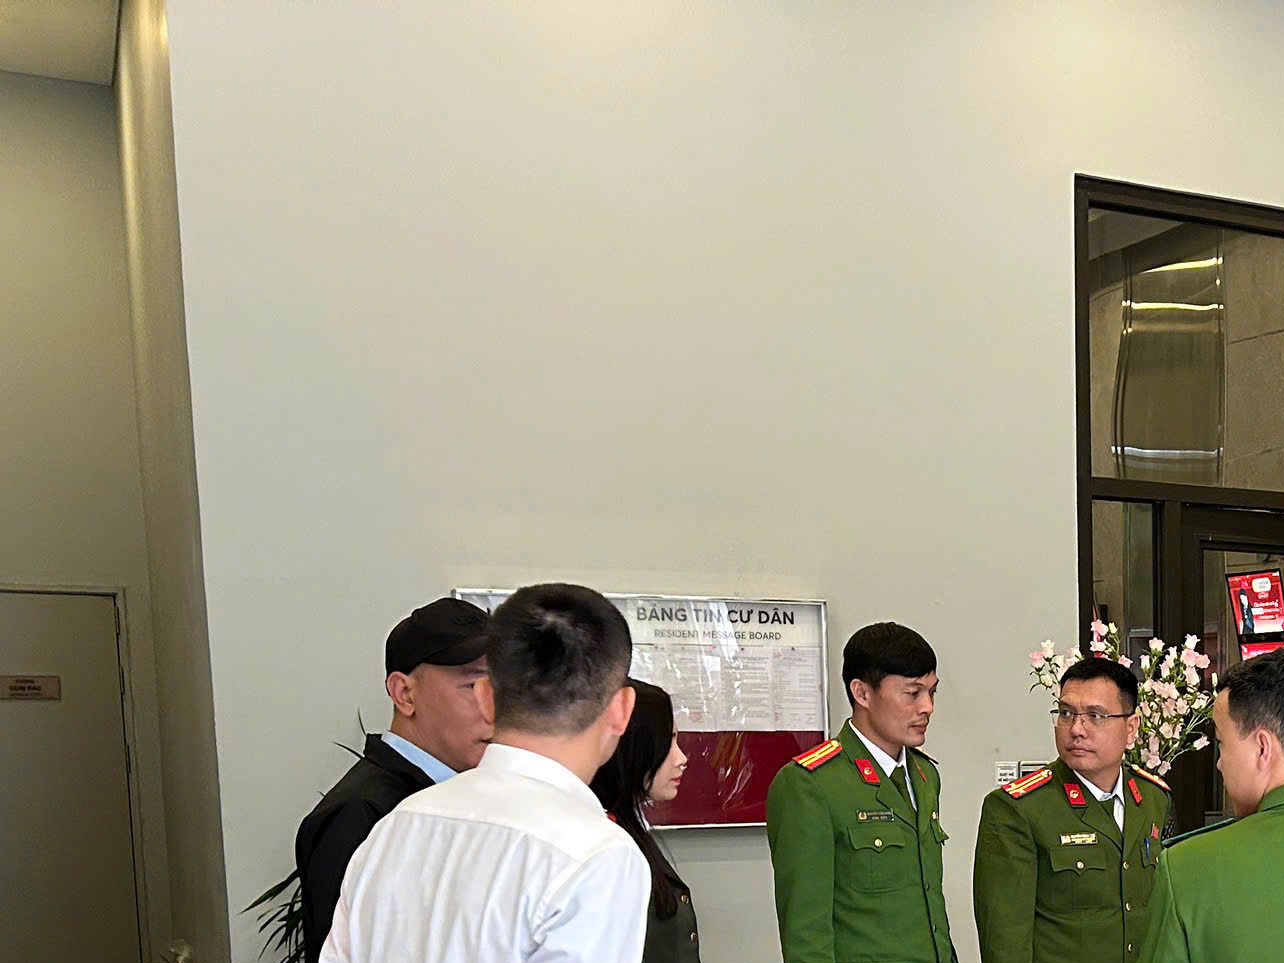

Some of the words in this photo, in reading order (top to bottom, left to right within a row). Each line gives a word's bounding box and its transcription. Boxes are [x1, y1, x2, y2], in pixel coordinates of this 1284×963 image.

[636, 604, 688, 622] BẢNG
[693, 608, 722, 622] TIN
[728, 608, 753, 624] CƯ
[758, 607, 795, 625] DÂN
[654, 629, 699, 639] RESIDENT
[703, 630, 748, 640] MESSAGE
[749, 631, 782, 641] BOARD
